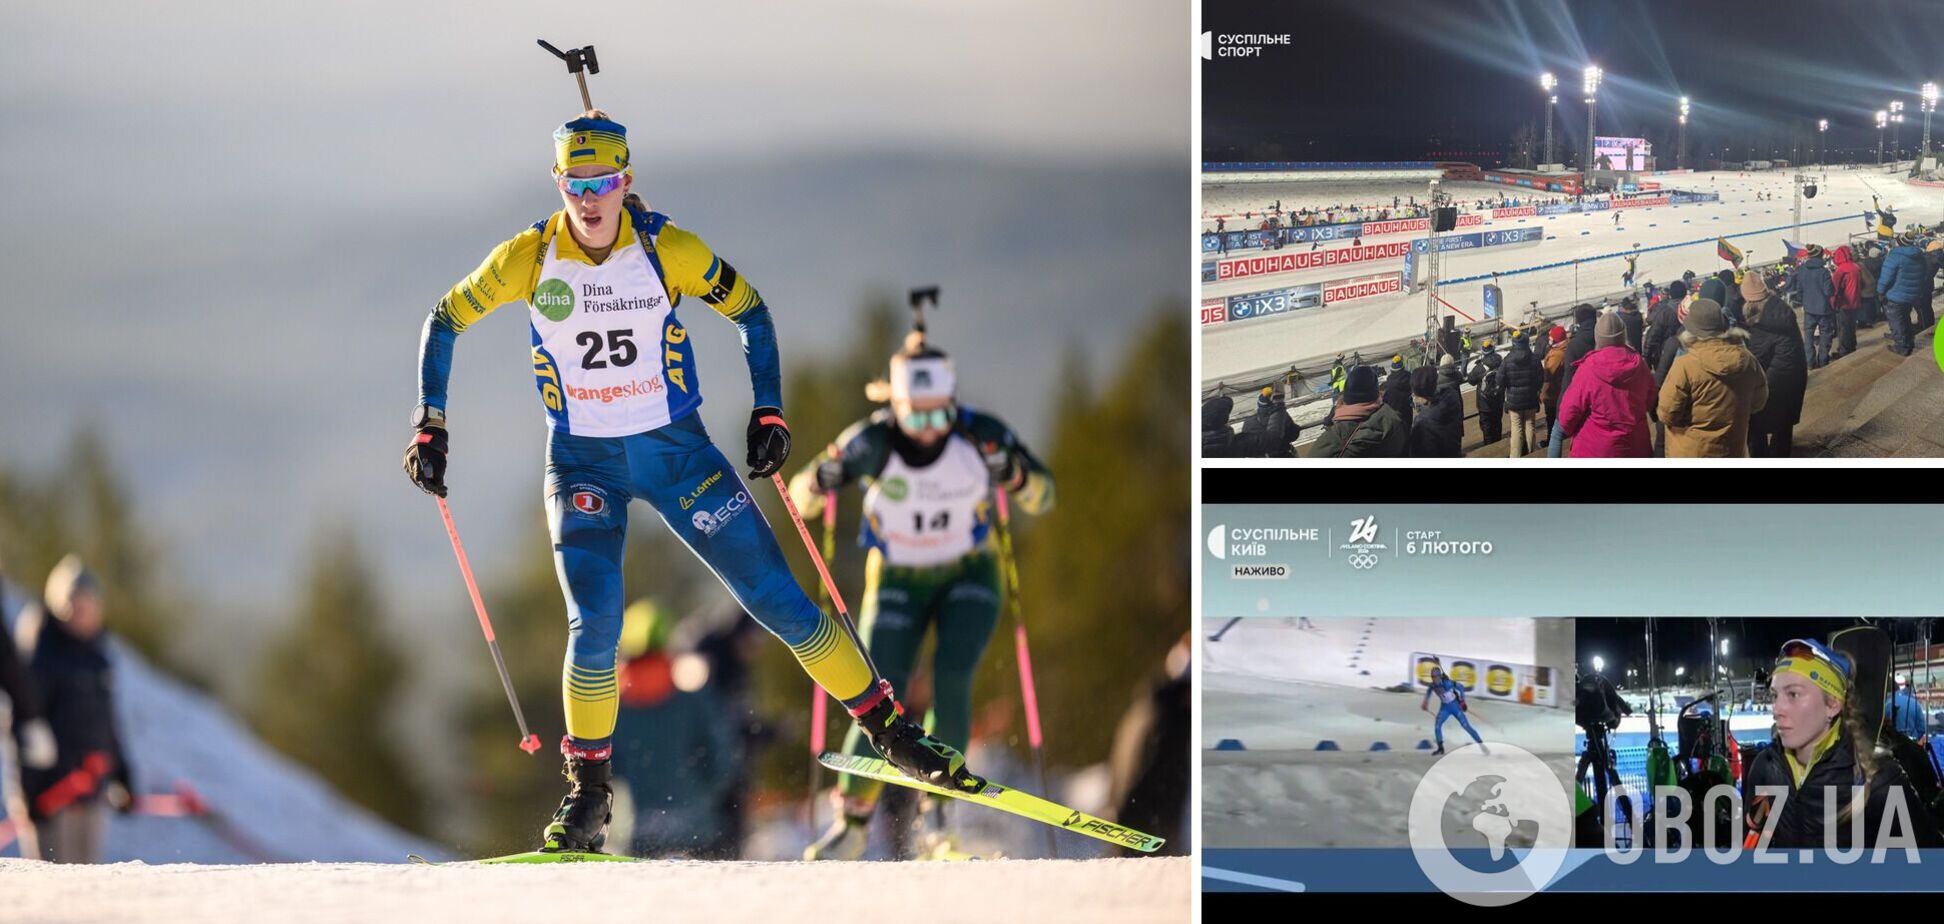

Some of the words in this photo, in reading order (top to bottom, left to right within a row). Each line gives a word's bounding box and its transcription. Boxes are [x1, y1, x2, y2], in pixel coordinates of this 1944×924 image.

[1494, 207, 1536, 218] BAUHAUS
[1311, 228, 1333, 240] iX3
[1364, 220, 1426, 234] BAUHAUS
[1501, 231, 1519, 242] iX3
[1326, 242, 1409, 261] BAUHAUS
[1220, 253, 1322, 276] BAUHAUS
[537, 293, 571, 306] dina
[582, 284, 613, 297] Dina
[1325, 280, 1398, 302] BAUHAUS
[1255, 296, 1285, 315] iX3
[576, 329, 638, 370] 25
[665, 324, 688, 394] ATG
[531, 347, 563, 412] ATG
[583, 495, 595, 510] 1
[714, 491, 747, 522] ECO
[1081, 819, 1151, 848] FISCHER
